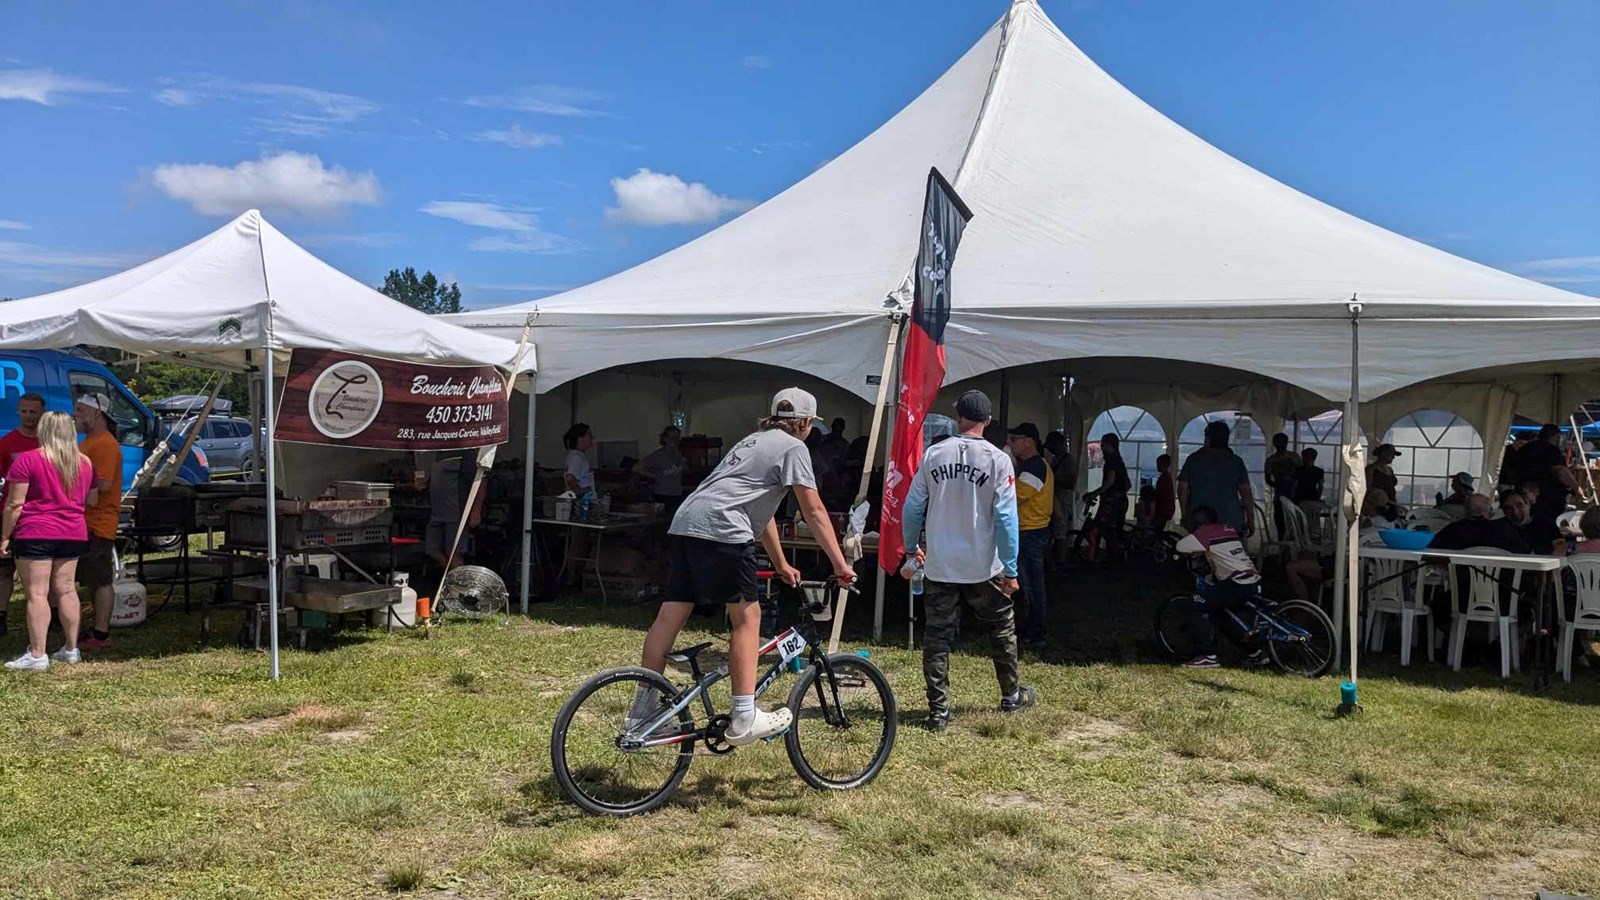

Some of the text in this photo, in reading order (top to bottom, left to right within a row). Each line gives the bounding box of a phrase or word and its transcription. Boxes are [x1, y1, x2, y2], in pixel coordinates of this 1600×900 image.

[410, 375, 502, 399] Boucherie Champlain
[425, 404, 493, 423] 450 373-3141
[397, 428, 416, 440] 283,
[431, 429, 458, 441] Jacques
[930, 463, 990, 488] PHIPPEN
[781, 636, 801, 656] 162
